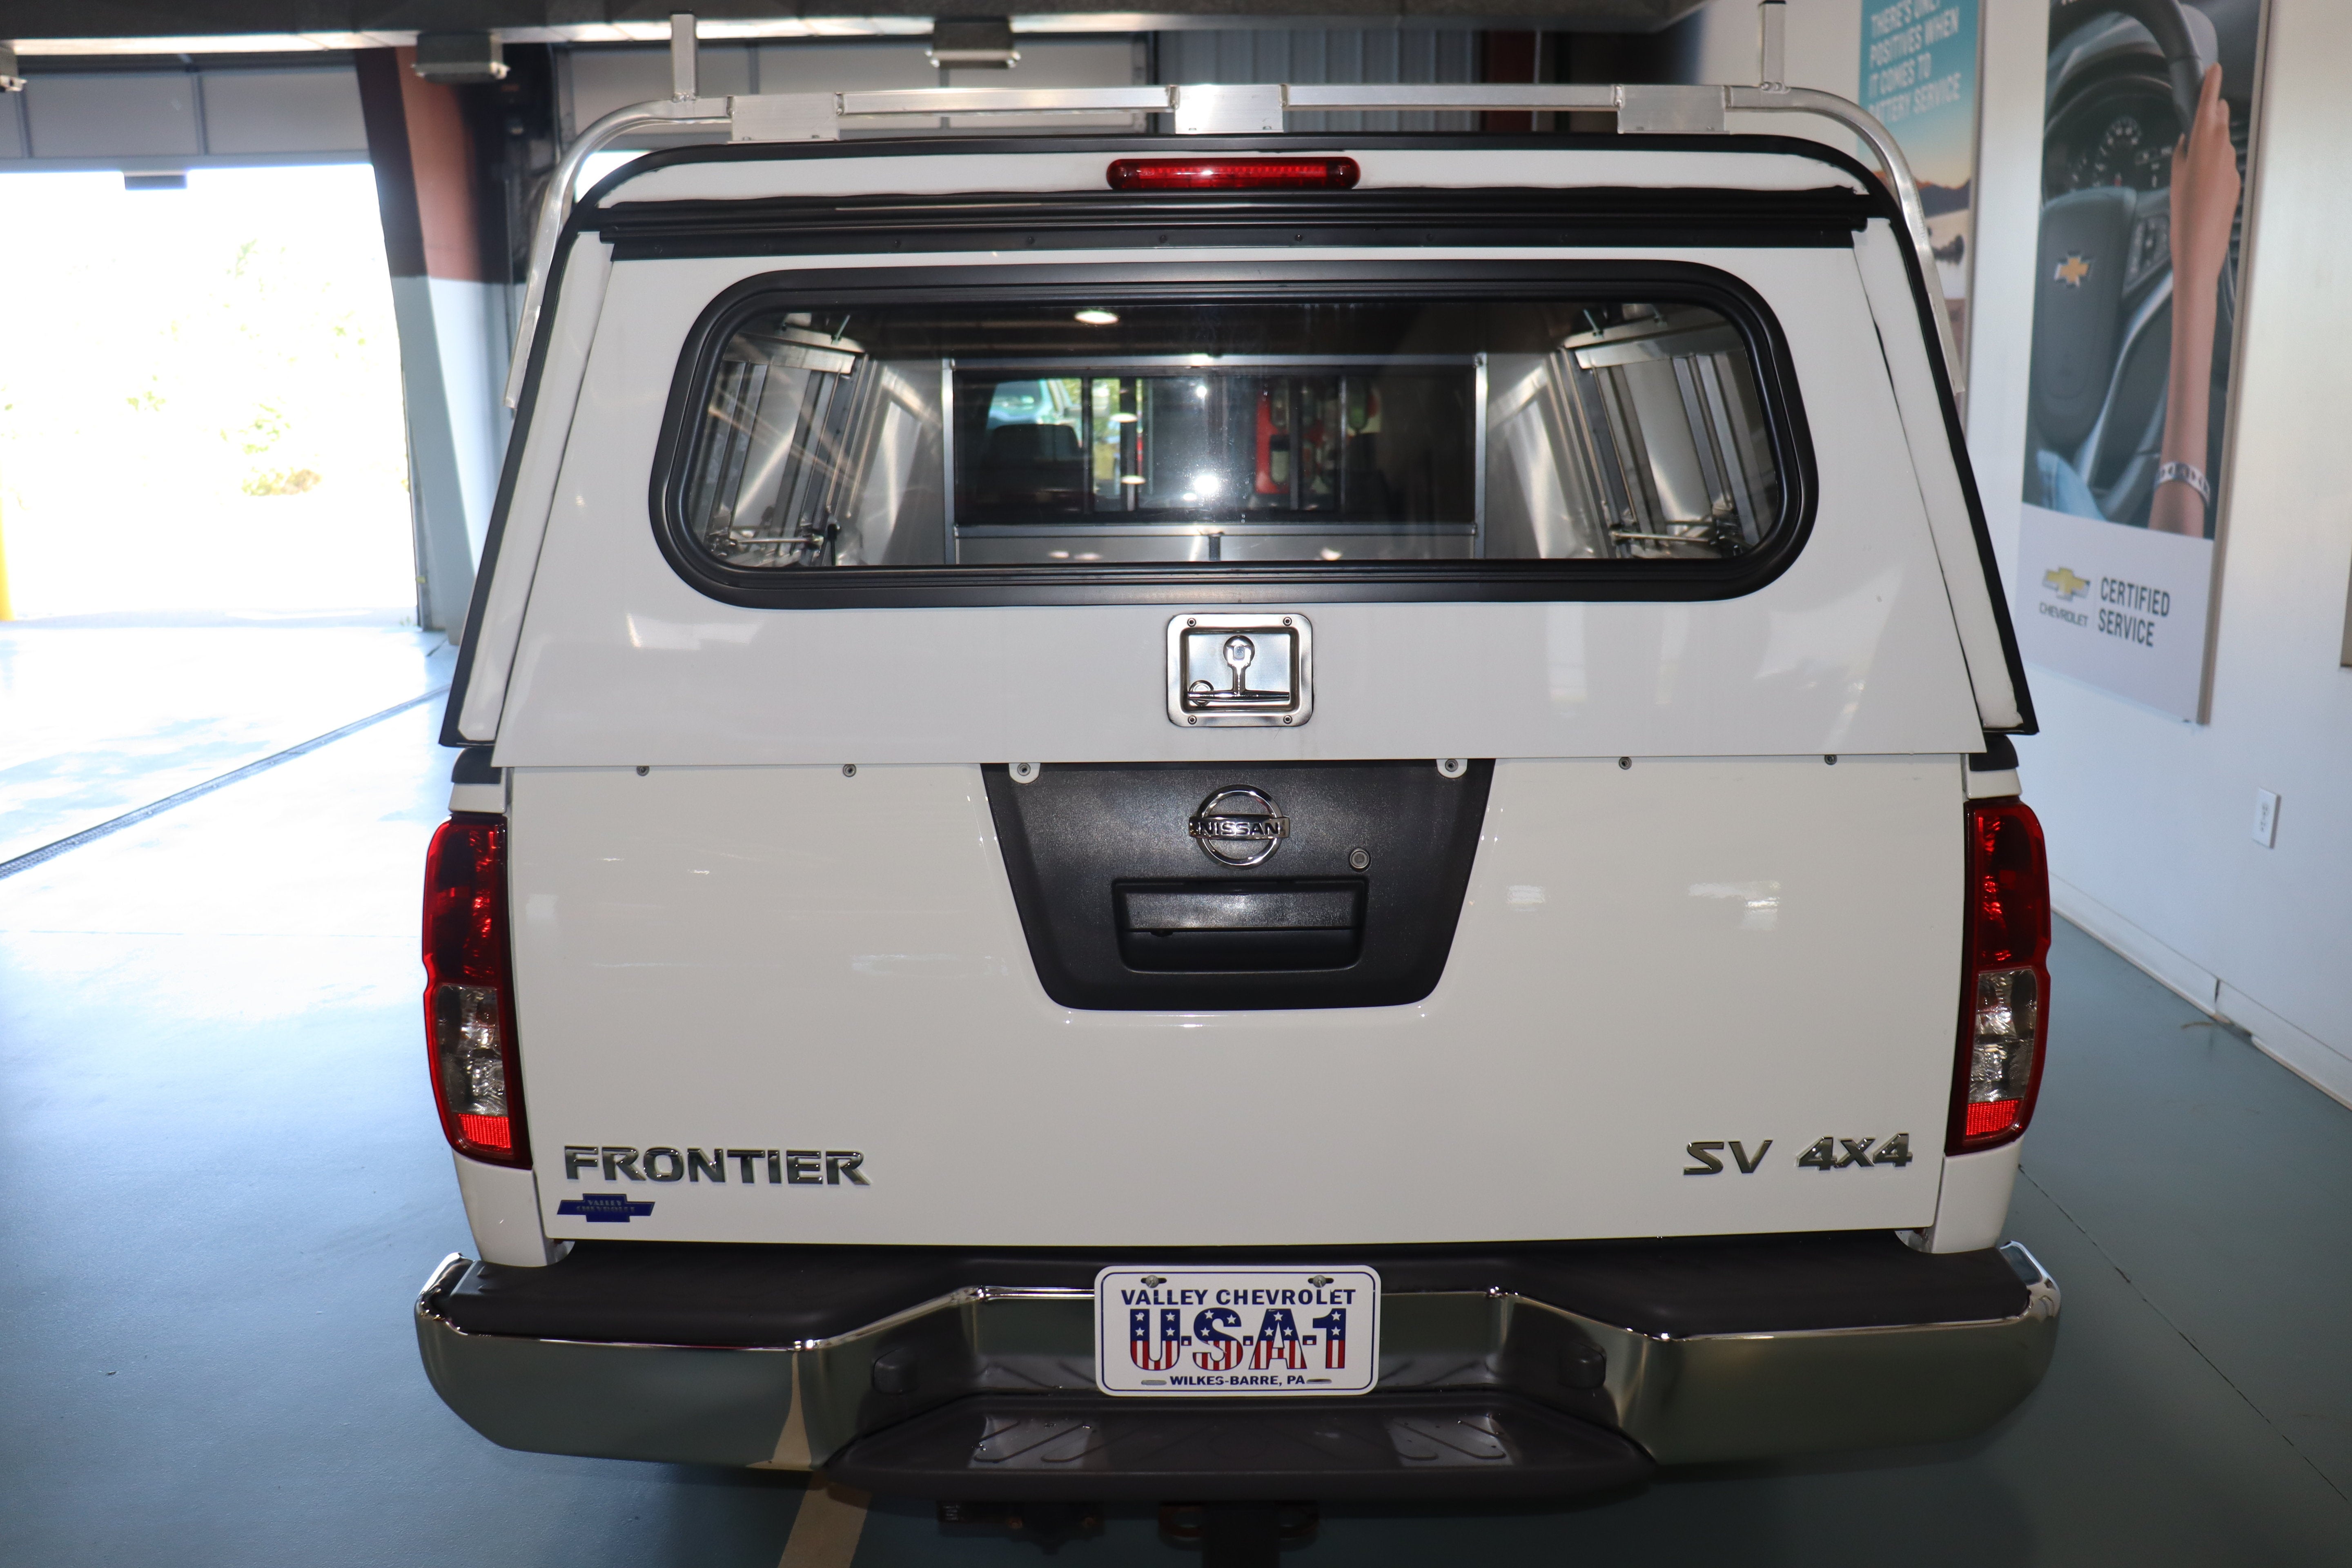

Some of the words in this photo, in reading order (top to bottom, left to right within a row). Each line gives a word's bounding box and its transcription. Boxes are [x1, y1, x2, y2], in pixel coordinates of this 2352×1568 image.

[1869, 24, 1922, 69] POSITIVES
[1925, 7, 1959, 45] WHEN
[1869, 73, 1879, 98] IT
[1880, 58, 1915, 95] COMES
[1917, 52, 1931, 80] TO
[1914, 73, 1962, 114] SERVICE
[2039, 601, 2089, 627] CHEVROLET
[2101, 577, 2170, 617] CERTIFIED
[2098, 608, 2155, 647] SERVICE
[1198, 822, 1281, 835] NISSAN
[564, 1146, 871, 1185] FRONTIER
[1683, 1139, 1773, 1176] SV
[1121, 1289, 1209, 1305] VALLEY
[1216, 1289, 1356, 1305] CHEVROLET
[1170, 1376, 1282, 1387] WILKES-BARRE,
[1287, 1375, 1305, 1385] PA
